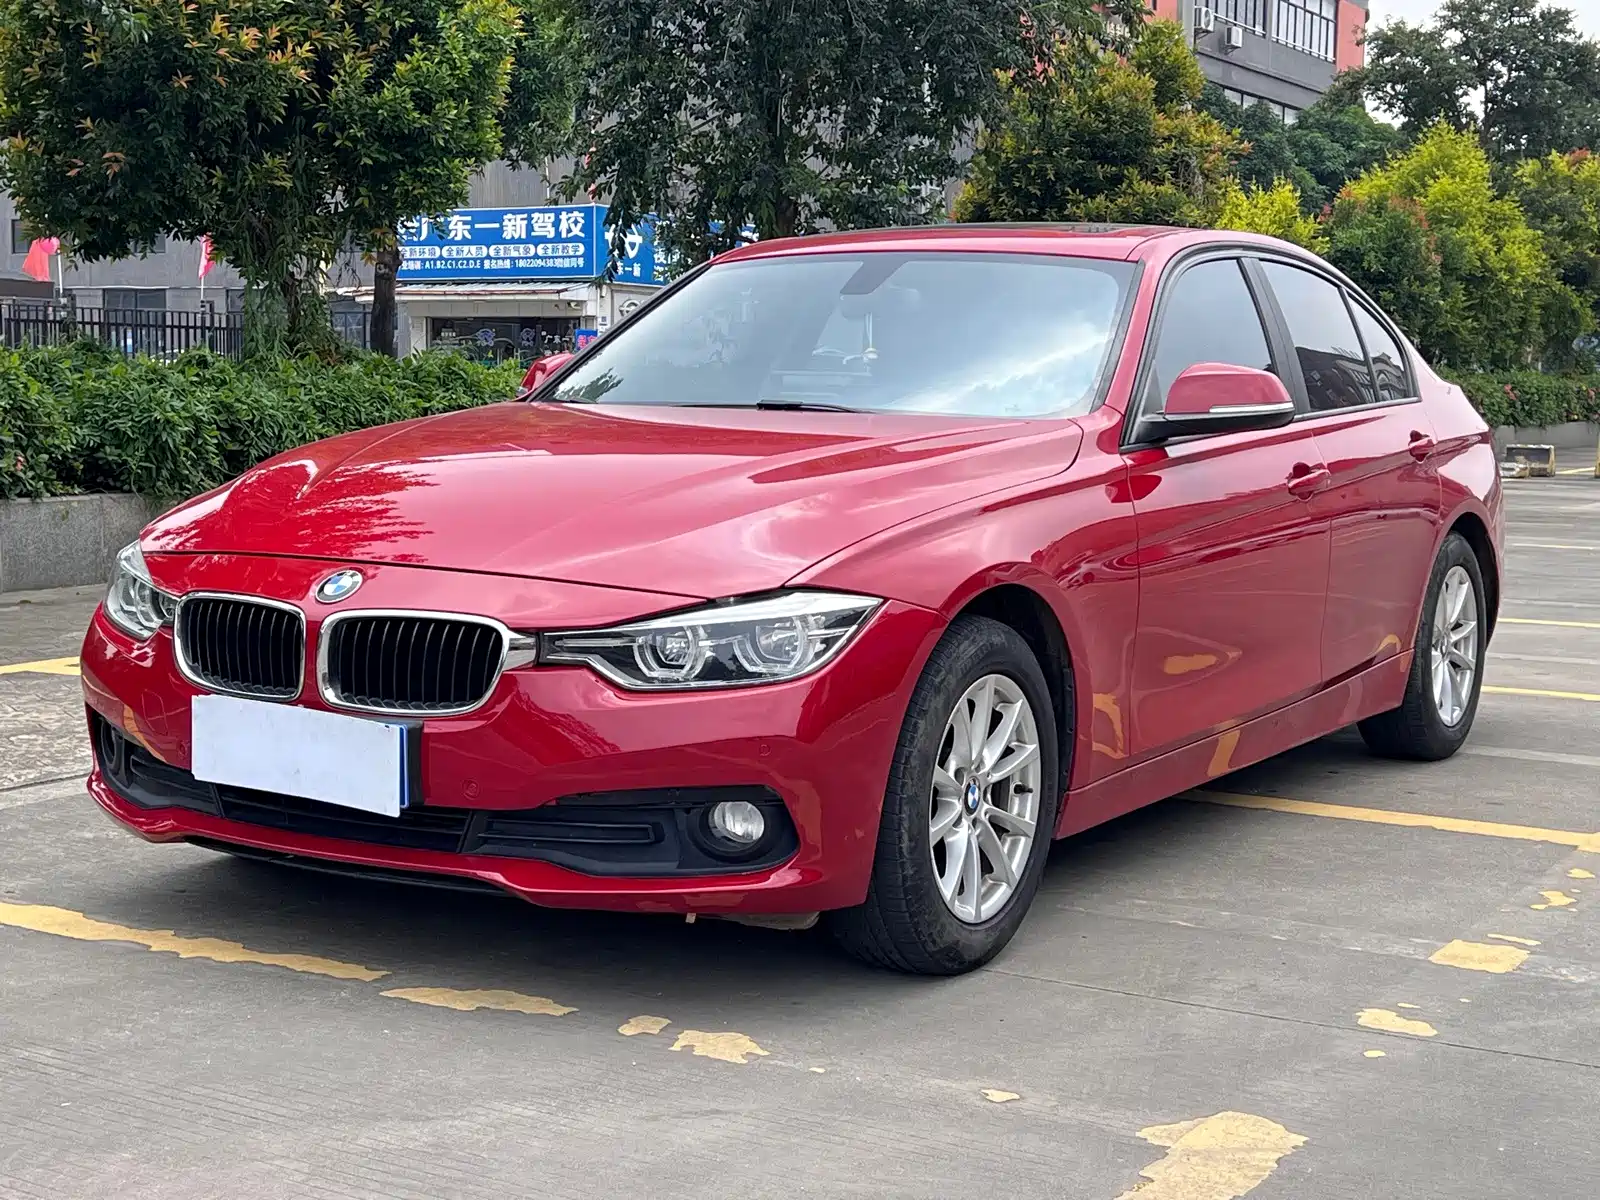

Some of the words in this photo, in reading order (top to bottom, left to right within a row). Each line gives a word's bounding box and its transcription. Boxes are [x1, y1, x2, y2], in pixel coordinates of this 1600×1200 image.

[445, 245, 484, 258] 全新人员
[492, 245, 531, 256] 全新气象
[541, 244, 580, 256] 全新教学
